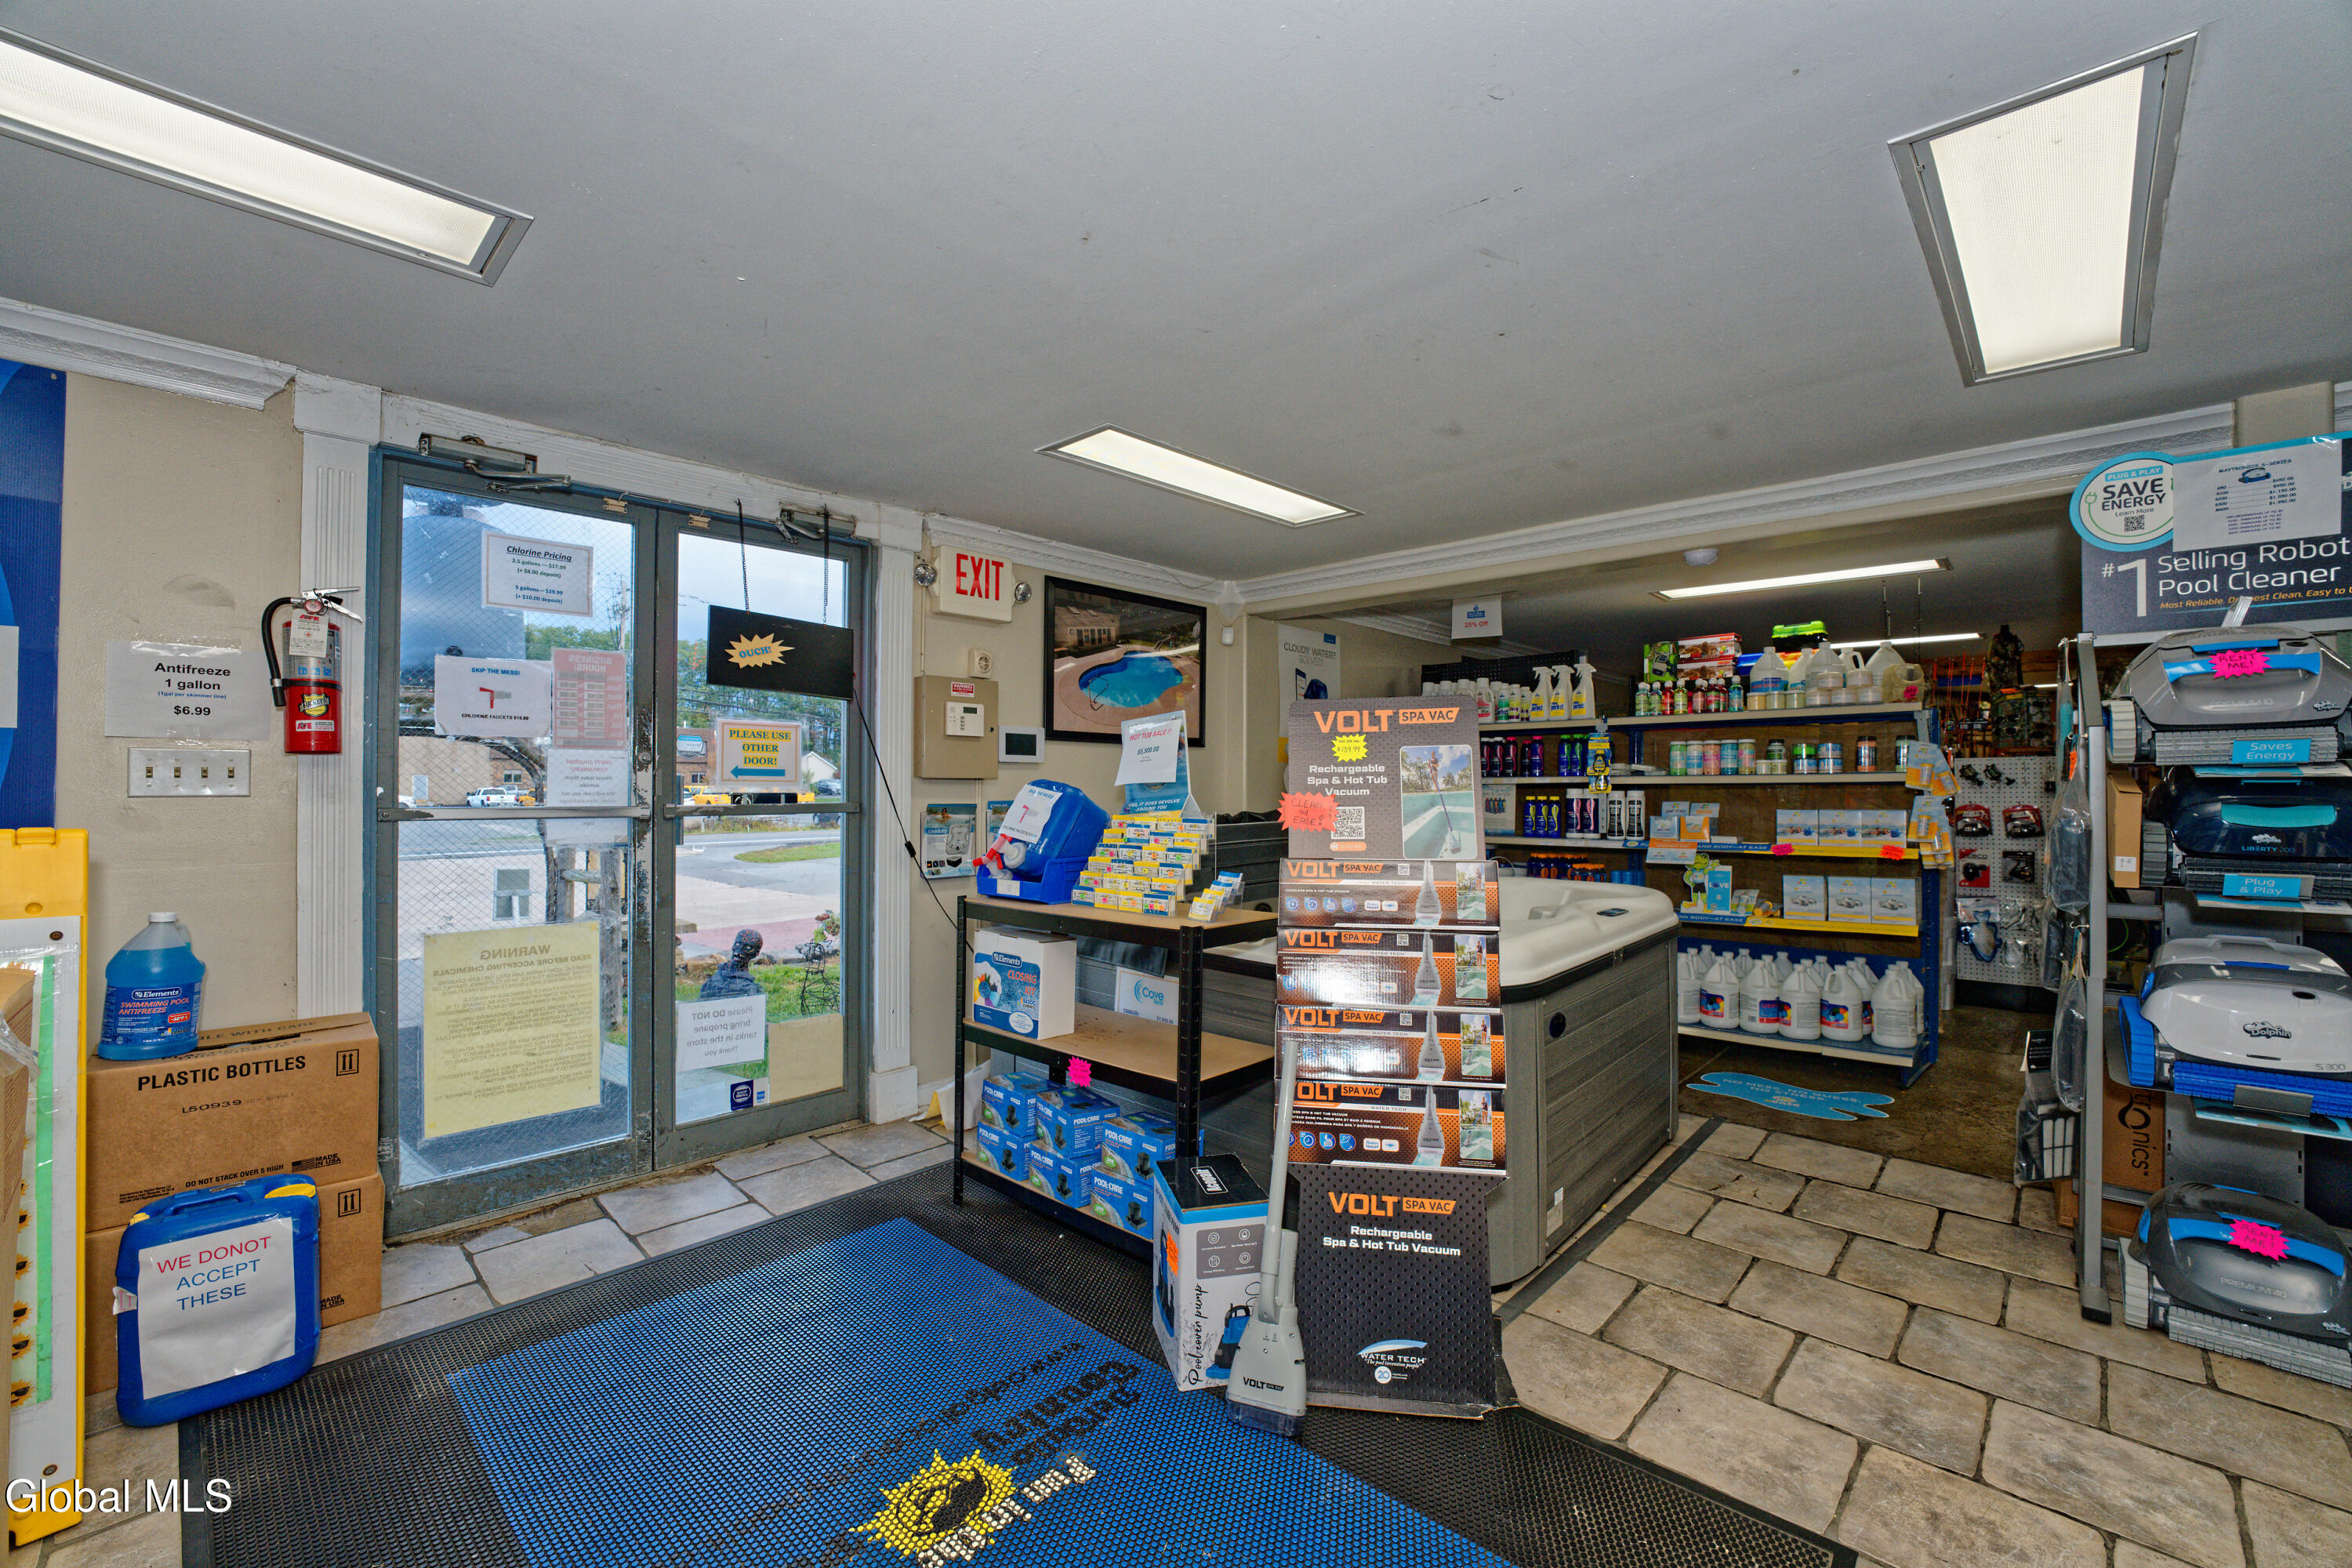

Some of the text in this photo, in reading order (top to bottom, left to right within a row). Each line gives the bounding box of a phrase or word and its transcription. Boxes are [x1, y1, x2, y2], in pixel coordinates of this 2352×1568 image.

[2140, 467, 2161, 476] PLAY
[2103, 477, 2164, 499] SAVE
[2101, 493, 2166, 511] ENERGY
[2136, 507, 2154, 516] More
[506, 546, 572, 562] Chlorine Pricing
[2158, 536, 2350, 574] Selling Robot
[539, 570, 561, 579] deposit)
[956, 553, 1004, 601] EXIT
[2158, 566, 2340, 597] Pool Cleaner
[541, 596, 563, 604] deposit)
[2160, 601, 2183, 609] Most
[2185, 597, 2226, 608] Reliable.
[2273, 590, 2303, 601] Clean.
[2306, 589, 2332, 599] Easy
[739, 646, 771, 658] OUCH!
[1283, 642, 1337, 659] CLOUDY WATER?
[154, 662, 230, 677] Antifreeze
[2228, 660, 2253, 669] ME!
[165, 680, 220, 692] 1 gallon
[158, 691, 173, 699] (1gal
[2210, 699, 2261, 708] PREMIUM
[173, 705, 211, 717] $6.99
[1314, 710, 1454, 733] VOLT SPA VAC
[729, 730, 791, 740] PLEASE USE
[1152, 729, 1167, 738] SALE
[742, 743, 779, 753] OTHER
[2250, 742, 2292, 751] Saves
[744, 757, 777, 765] DOOR!
[2246, 751, 2296, 761] Energy
[1309, 764, 1385, 774] Rechargeable
[1307, 776, 1329, 786] Spa
[1344, 775, 1363, 785] Hot
[1367, 775, 1388, 784] Tub
[1325, 787, 1370, 796] Vacuum
[1287, 862, 1340, 878] VOLT
[2245, 878, 2275, 887] Plug
[2253, 887, 2283, 896] Play
[1283, 931, 1340, 947] VOLT
[1361, 934, 1379, 942] VAC
[999, 955, 1021, 966] Elements
[1007, 970, 1036, 984] CLOSING
[143, 989, 180, 998] Elements
[1025, 987, 1036, 996] KIT
[1142, 987, 1164, 1000] Cove
[1283, 1007, 1381, 1026] VOLT SPA VAC
[230, 1028, 271, 1036] WITH
[2249, 1023, 2292, 1039] Dolphin
[138, 1056, 307, 1091] PLASTIC BOTTLES
[1362, 1087, 1380, 1096] VAC
[316, 1153, 339, 1162] MADE
[325, 1157, 341, 1166] USA
[198, 1177, 213, 1185] NOT
[216, 1173, 238, 1183] STACK
[240, 1169, 259, 1178] OVER
[267, 1164, 284, 1173] HIGH
[1328, 1192, 1399, 1217] VOLT
[1351, 1225, 1432, 1241] Rechargeable
[2241, 1223, 2275, 1241] RENT
[1323, 1237, 1461, 1256] Spa Hot Tub Vacuum
[157, 1236, 271, 1274] WE DONOT
[176, 1258, 260, 1291] ACCEPT
[2220, 1276, 2271, 1295] PREMIUM
[177, 1283, 246, 1311] THESE
[1195, 1283, 1208, 1319] pump
[1360, 1352, 1427, 1364] WATER TECH
[1188, 1352, 1203, 1385] Pool
[1377, 1370, 1391, 1379] 20
